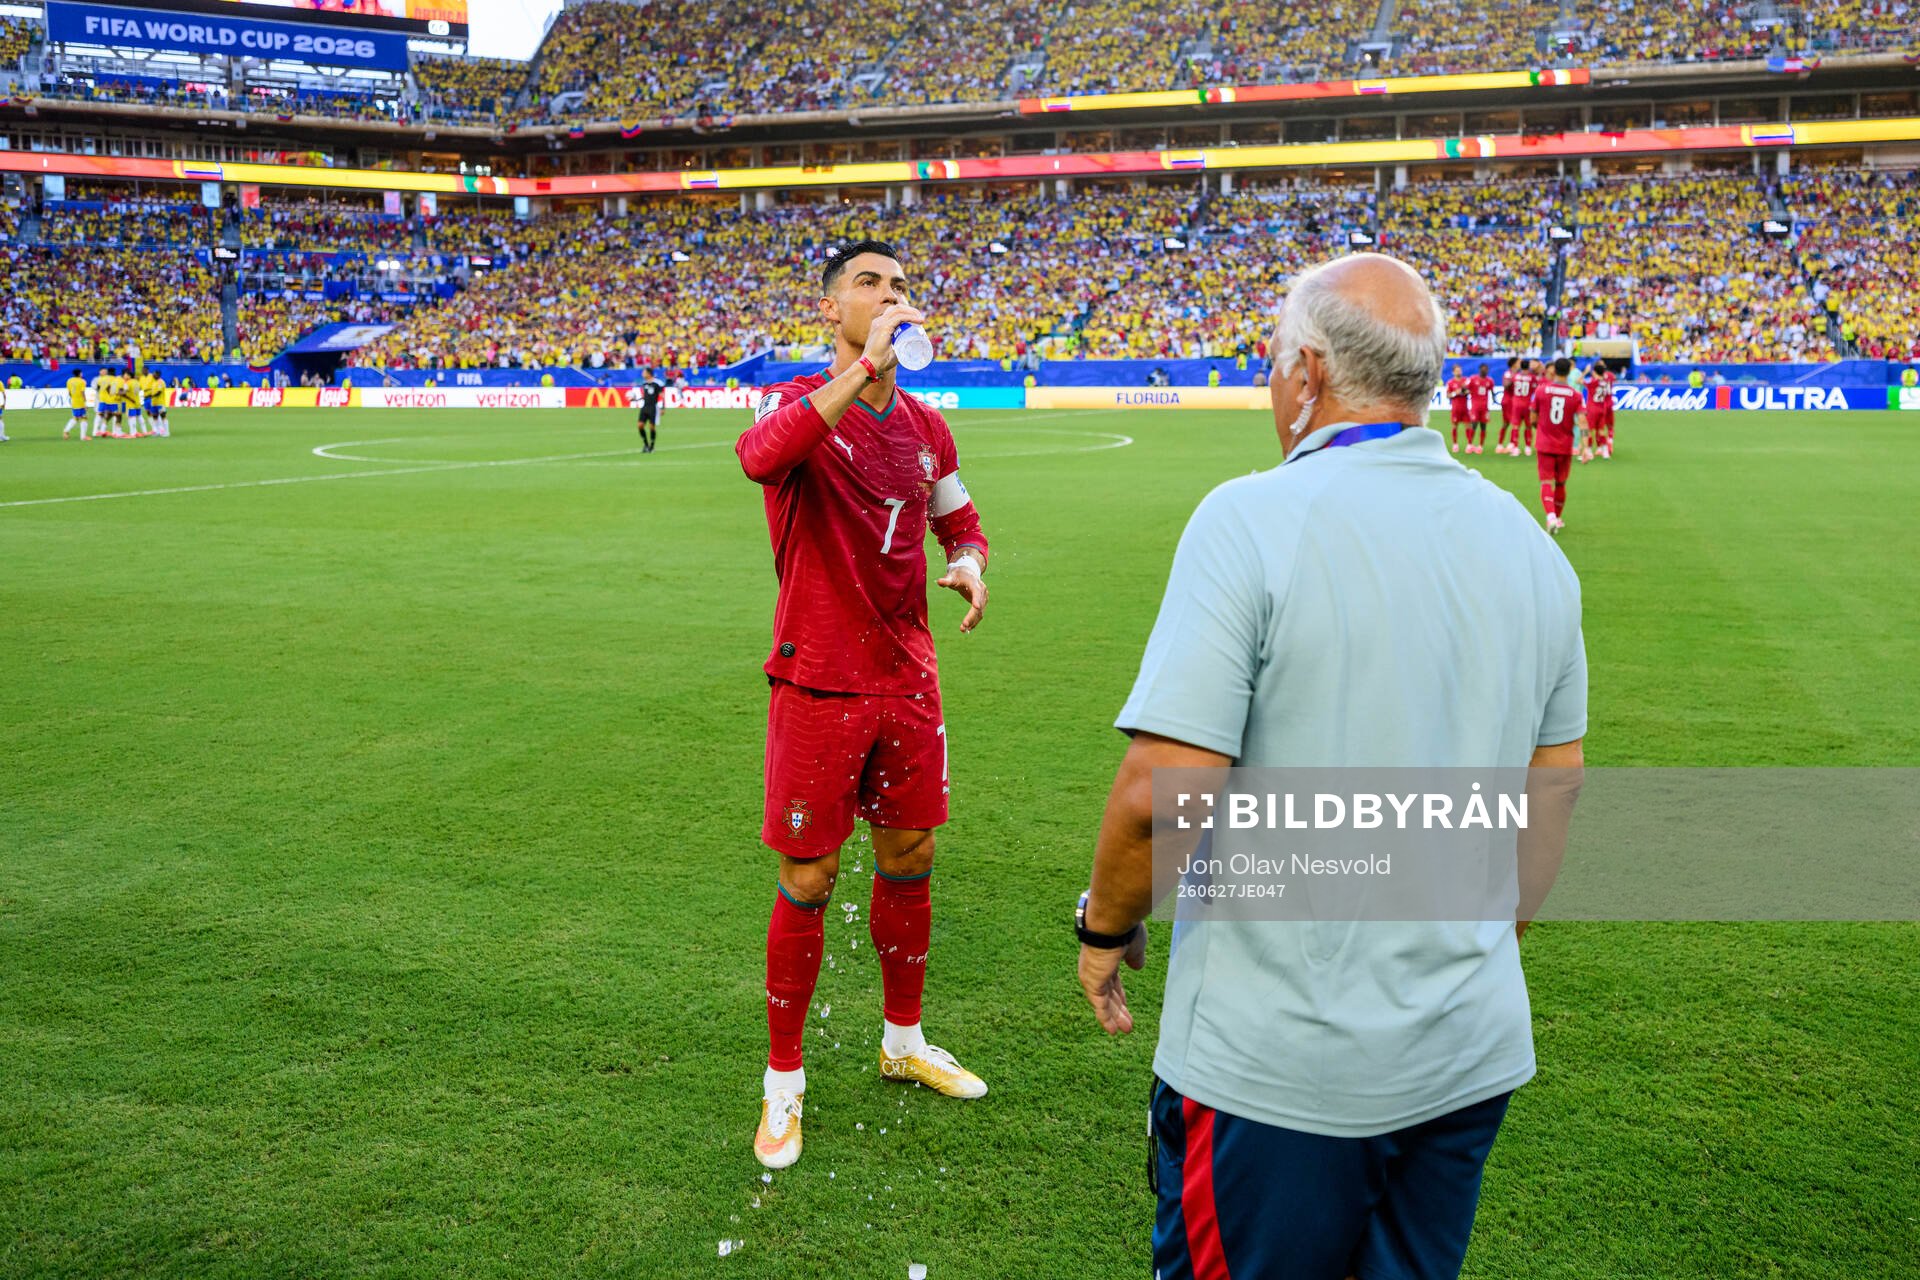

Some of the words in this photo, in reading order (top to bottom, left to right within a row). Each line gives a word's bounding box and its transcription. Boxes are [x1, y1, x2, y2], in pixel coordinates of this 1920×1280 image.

[85, 15, 142, 39] FIFA
[144, 22, 237, 47] WORLD
[241, 29, 290, 51] CUP
[293, 35, 377, 59] 2026
[457, 372, 482, 386] FIFA
[32, 388, 73, 409] Dov
[384, 393, 446, 408] verizon
[476, 393, 541, 408] verizon
[1116, 391, 1180, 405] FLORIDA
[1612, 386, 1709, 410] Michelob
[1739, 386, 1849, 410] ULTRA
[1550, 395, 1566, 424] 8
[880, 497, 906, 554] 7
[882, 1059, 907, 1076] CR7
